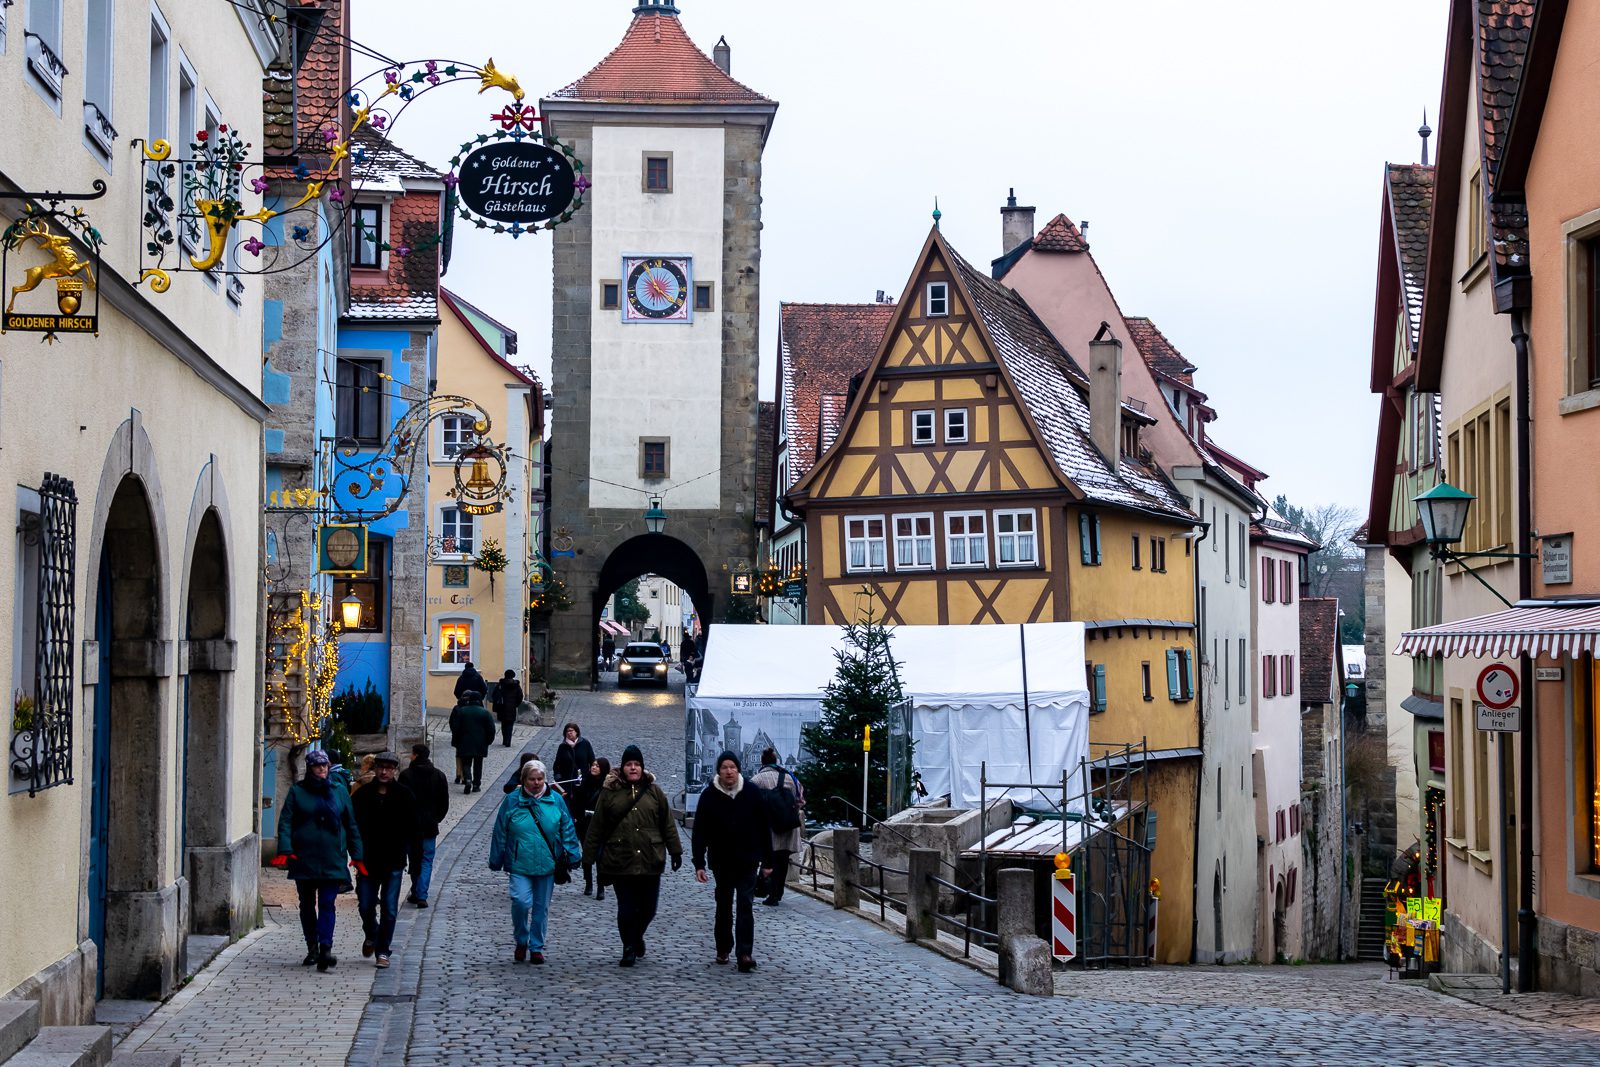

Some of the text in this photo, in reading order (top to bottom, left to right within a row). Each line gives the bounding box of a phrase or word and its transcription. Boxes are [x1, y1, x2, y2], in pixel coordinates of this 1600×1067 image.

[491, 156, 541, 171] Goldener
[479, 173, 553, 196] Hirsch
[484, 199, 547, 215] Gästehaus
[8, 317, 92, 329] GOLDENER HIRSCH
[463, 503, 498, 514] GASTHO
[1481, 709, 1515, 719] Anlieger
[1491, 719, 1506, 728] frei
